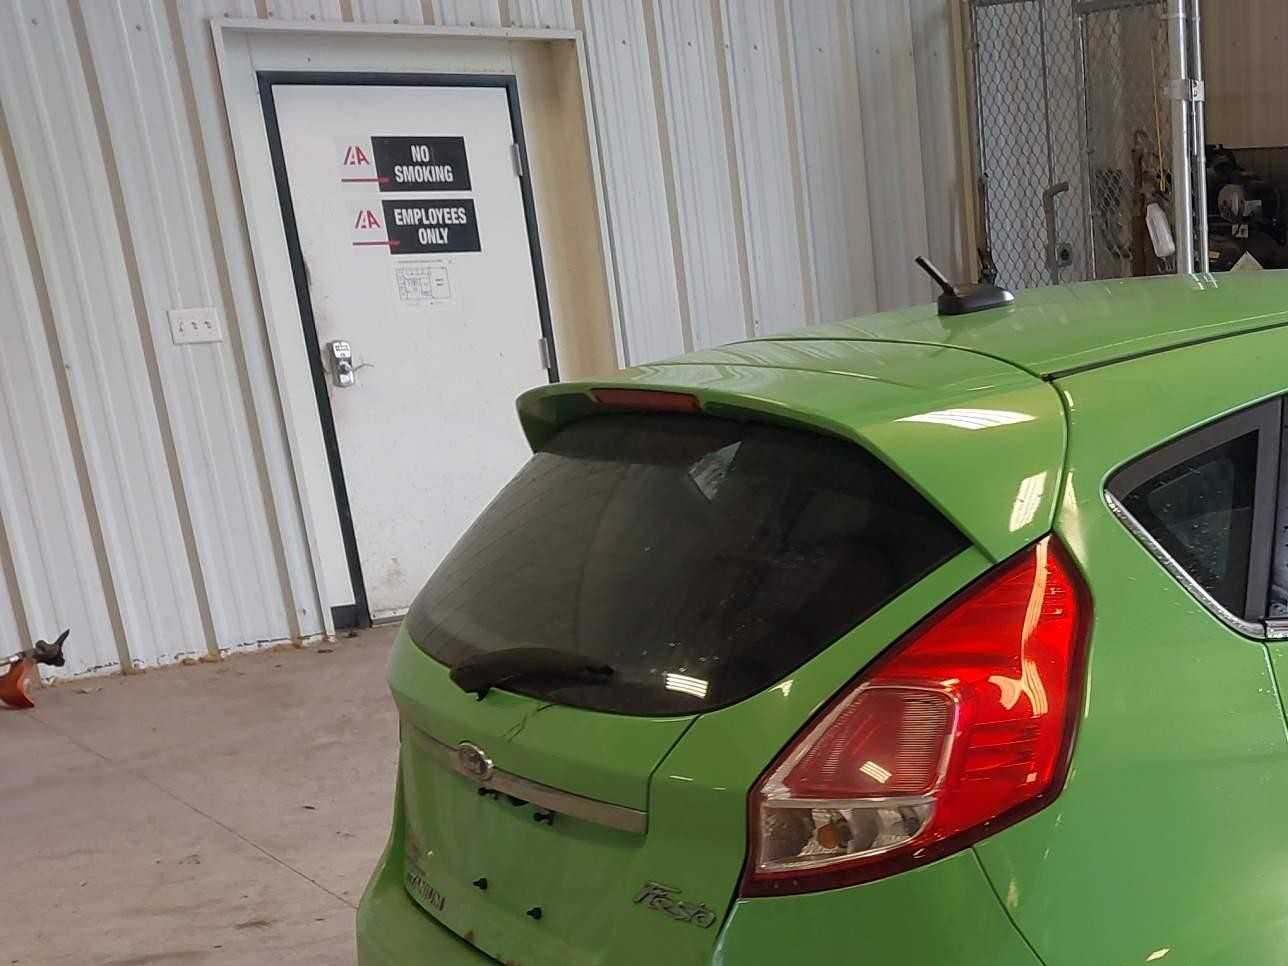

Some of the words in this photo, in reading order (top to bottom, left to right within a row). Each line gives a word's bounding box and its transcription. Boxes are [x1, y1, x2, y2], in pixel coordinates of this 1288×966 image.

[410, 144, 430, 163] NO
[394, 165, 454, 183] SMOKING
[393, 207, 468, 226] EMPLOYEES
[418, 227, 449, 245] ONLY
